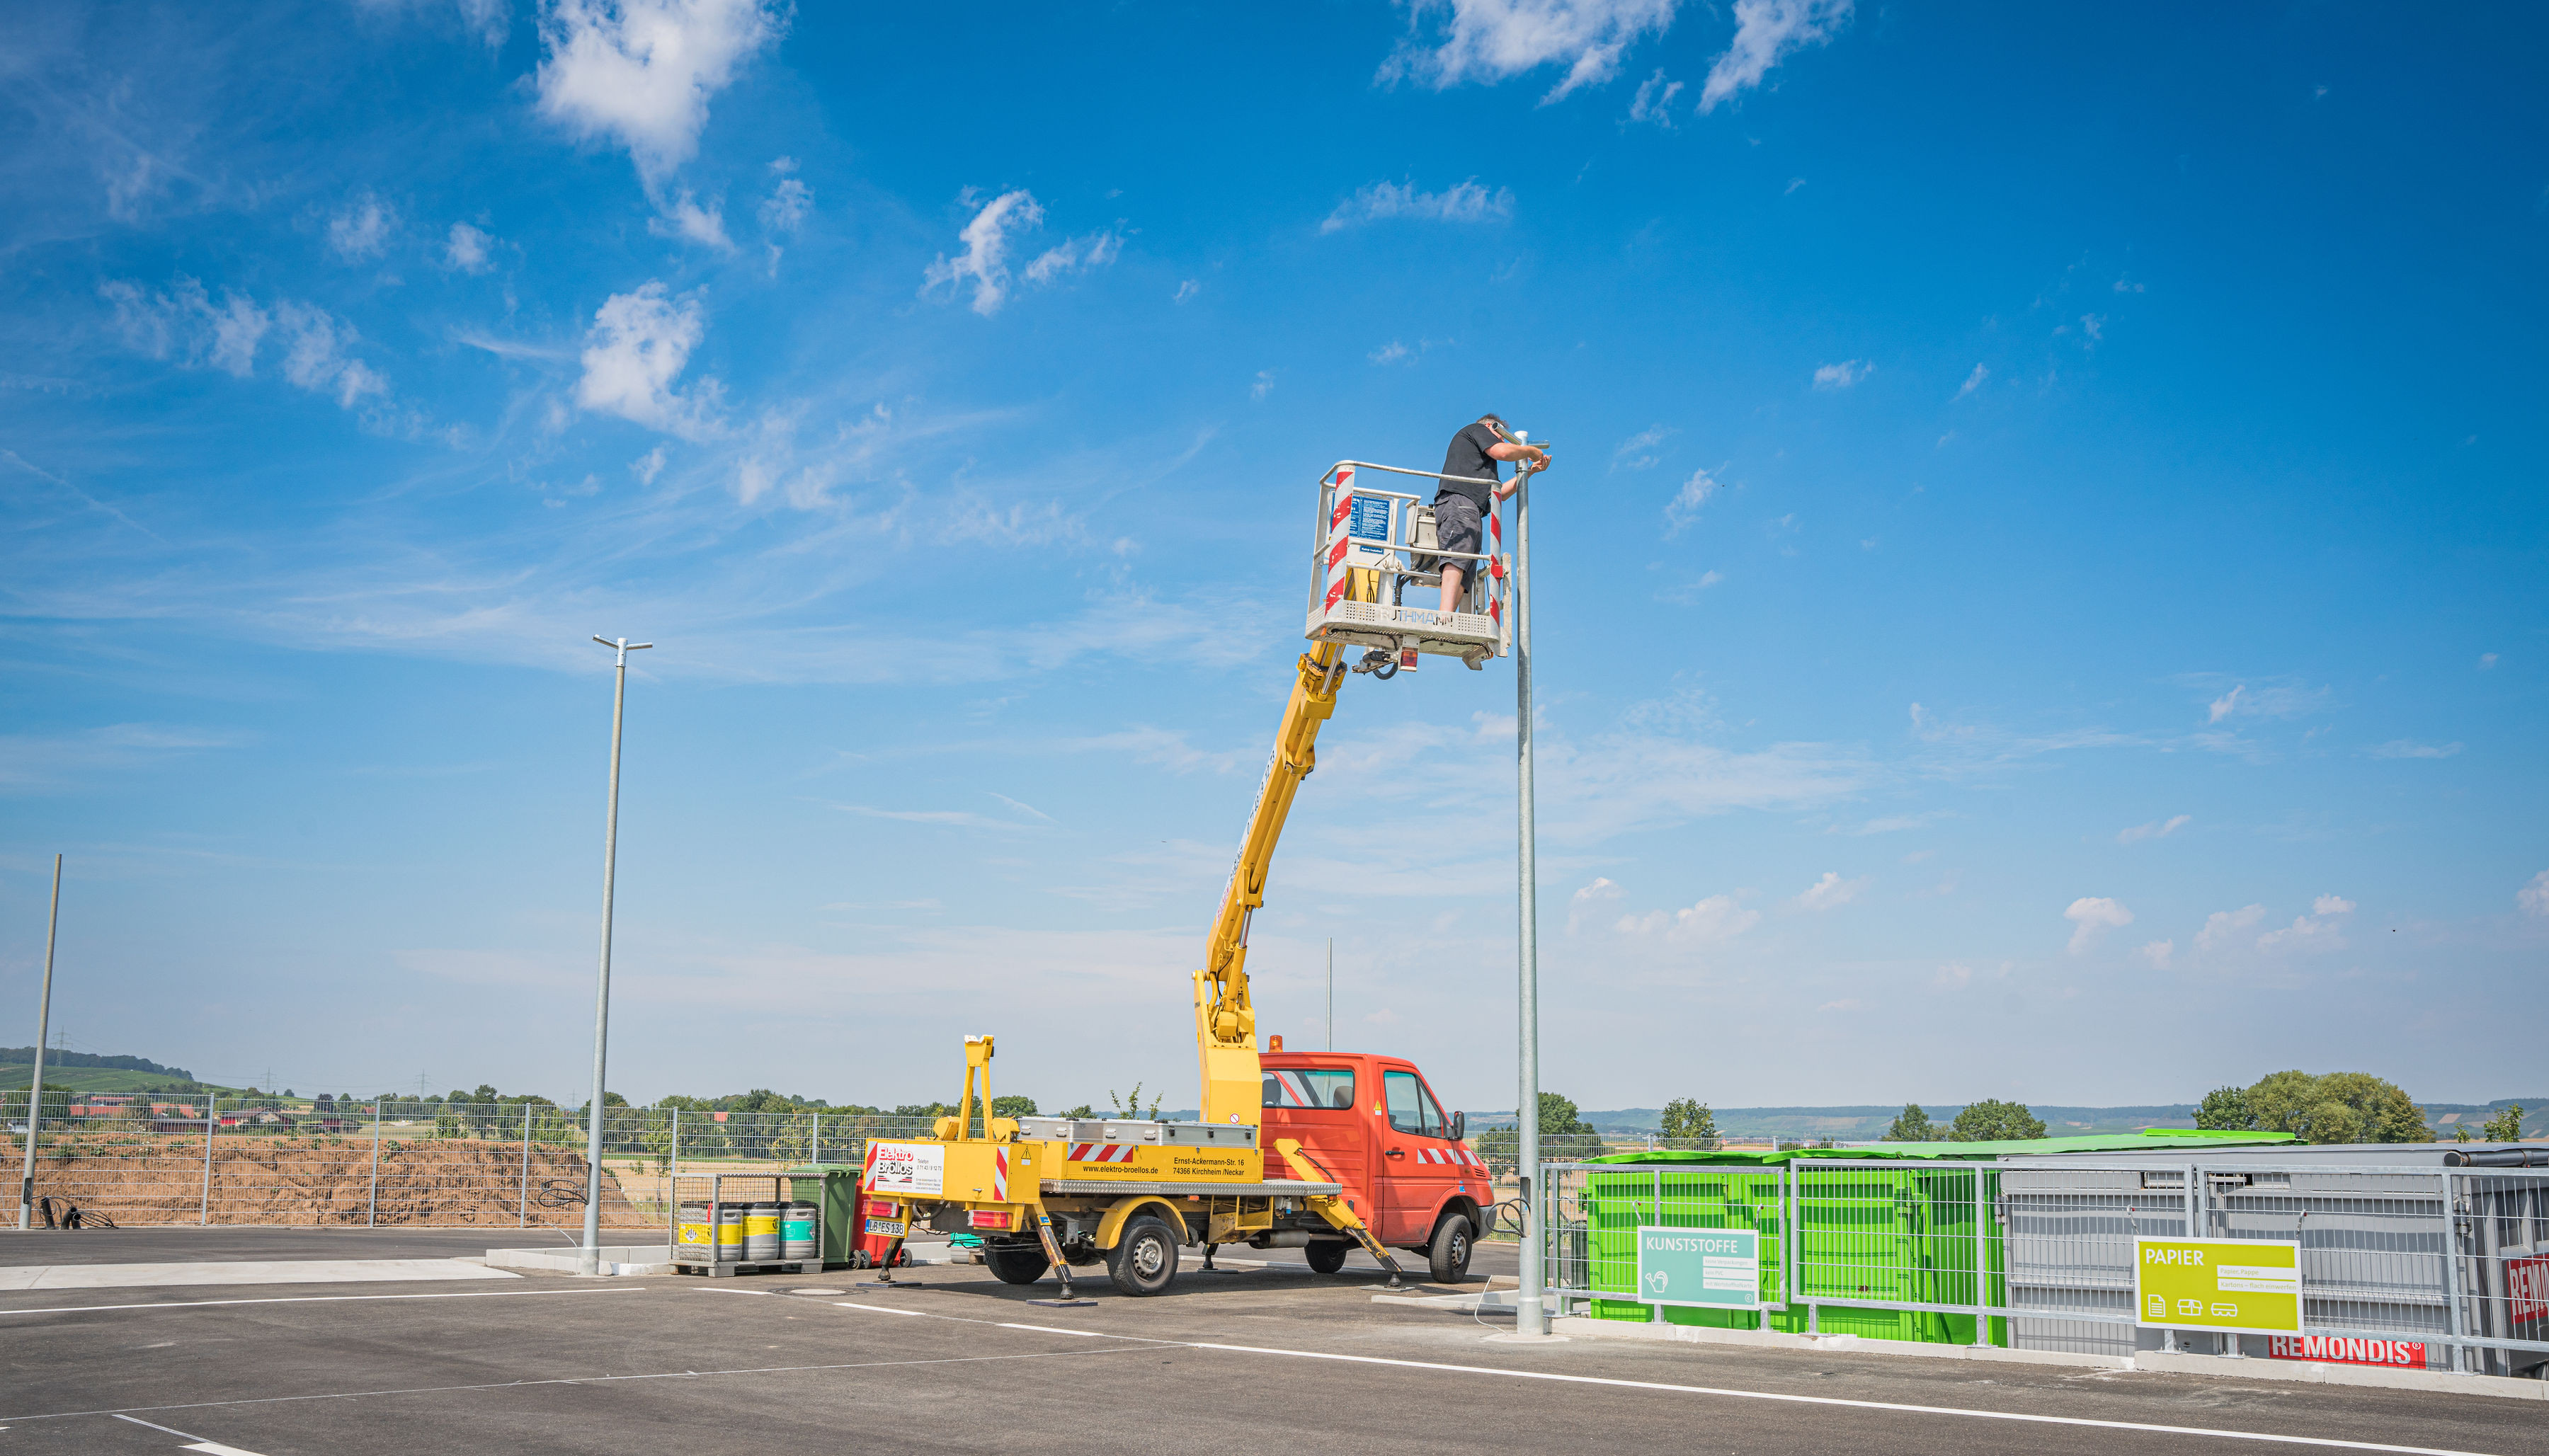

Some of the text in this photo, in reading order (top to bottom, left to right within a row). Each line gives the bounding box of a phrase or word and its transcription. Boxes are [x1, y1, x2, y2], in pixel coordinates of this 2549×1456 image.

[879, 1147, 913, 1162] Elektro
[1174, 1157, 1236, 1166] Ernst-Ackermann-Str.
[878, 1161, 913, 1175] Bröllos
[1083, 1165, 1158, 1175] www.elektro-broellos.de
[1192, 1167, 1221, 1176] Kirchheim
[869, 1221, 903, 1234] LB ES 138
[1646, 1237, 1738, 1254] KUNSTSTOFFE
[2145, 1249, 2204, 1266] PAPIER
[2510, 1261, 2549, 1317] REMO
